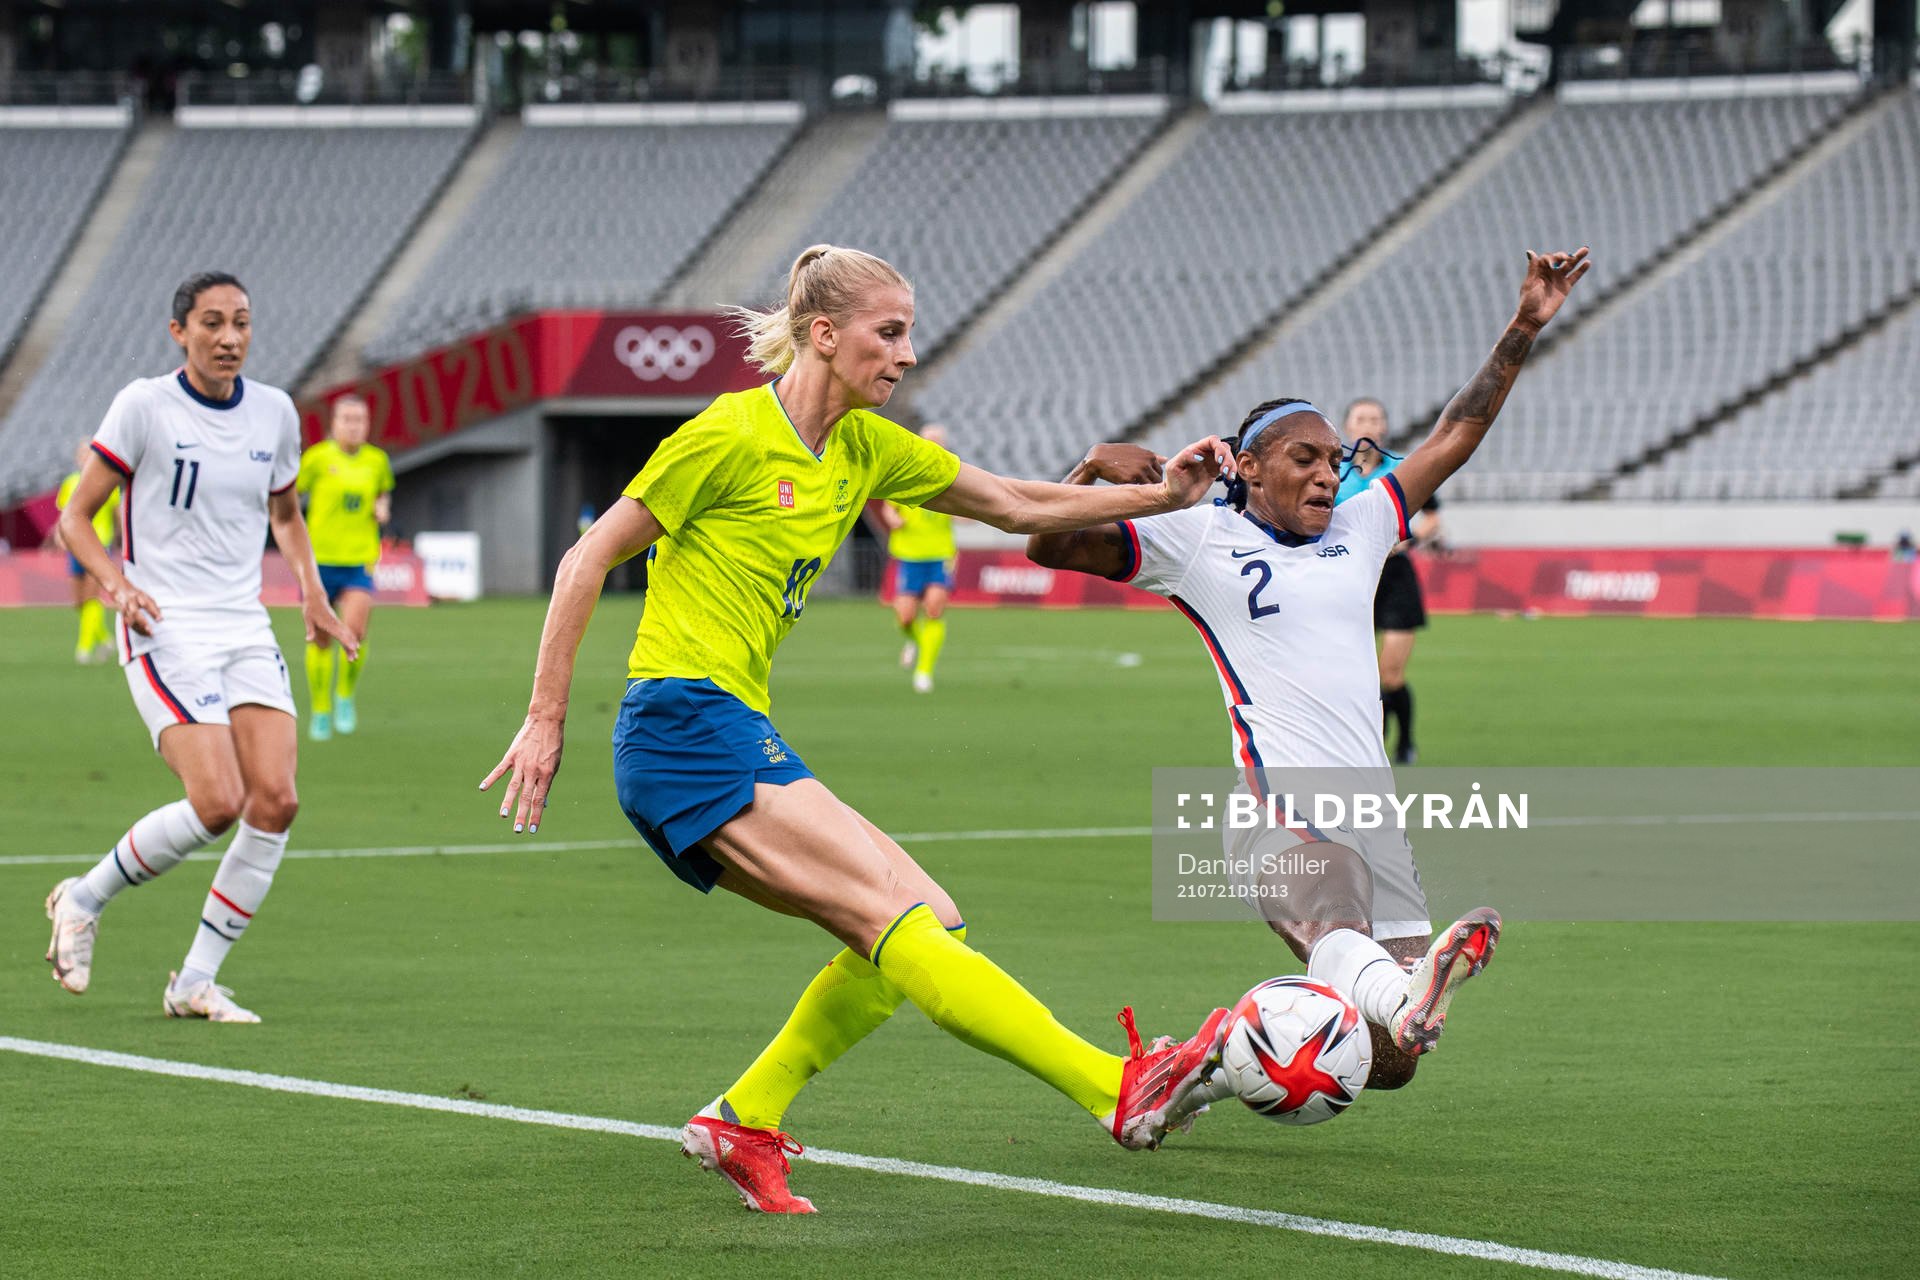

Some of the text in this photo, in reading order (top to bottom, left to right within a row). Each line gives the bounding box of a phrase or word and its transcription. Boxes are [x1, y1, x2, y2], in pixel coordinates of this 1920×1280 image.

[170, 458, 200, 510] 11
[780, 483, 792, 494] UNI
[780, 494, 793, 506] QLO
[1241, 560, 1280, 620] 2
